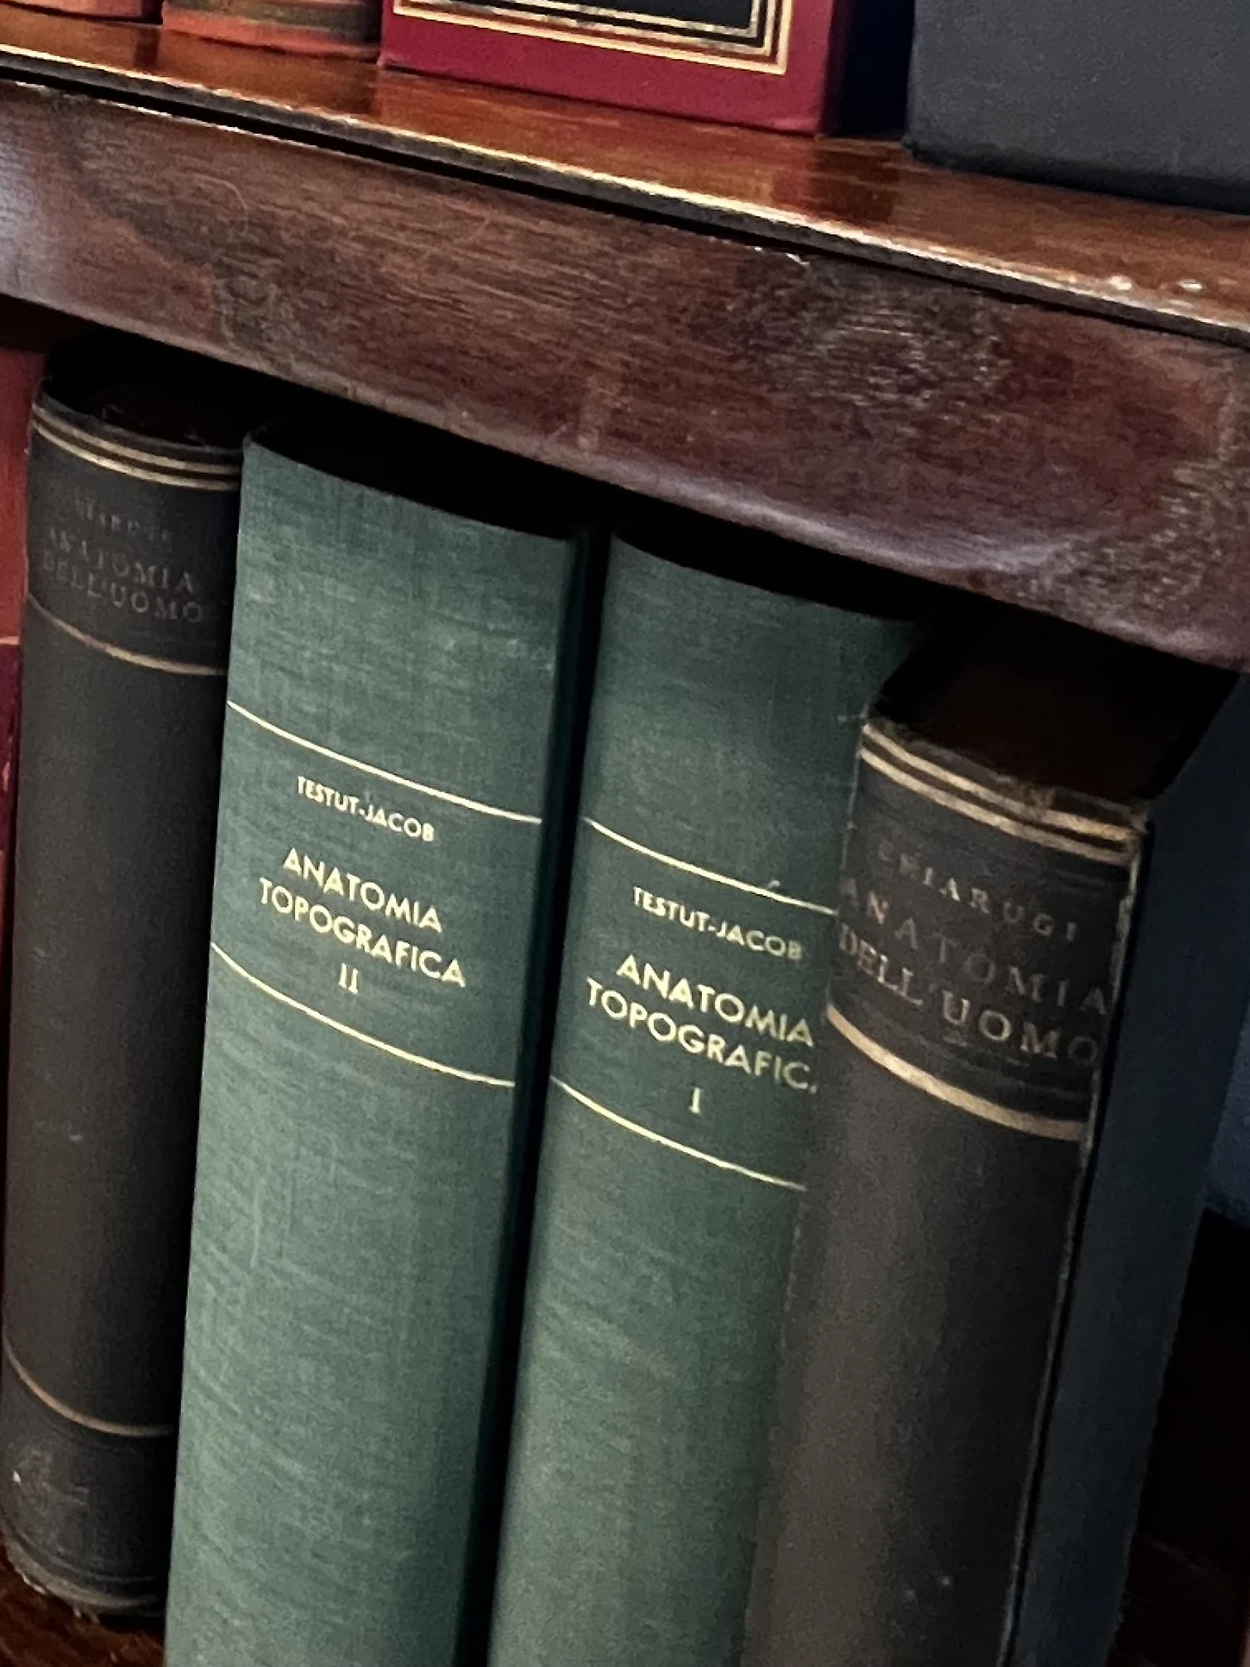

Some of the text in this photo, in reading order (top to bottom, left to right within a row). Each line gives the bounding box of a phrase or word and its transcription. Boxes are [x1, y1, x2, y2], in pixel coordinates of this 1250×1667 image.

[297, 775, 435, 842] TESTUT-JACOB
[259, 876, 467, 988] TOPOGRAFICA
[283, 847, 442, 934] ANATOMIA
[633, 885, 803, 961] TESTUT-JACOB
[337, 961, 359, 994] II
[839, 877, 1107, 1016] ANATOMIA
[587, 976, 818, 1094] TOPOGRAFIC
[616, 953, 814, 1048] ANATOMIA
[838, 924, 1099, 1065] DELL'UOMO
[689, 1086, 702, 1114] I
